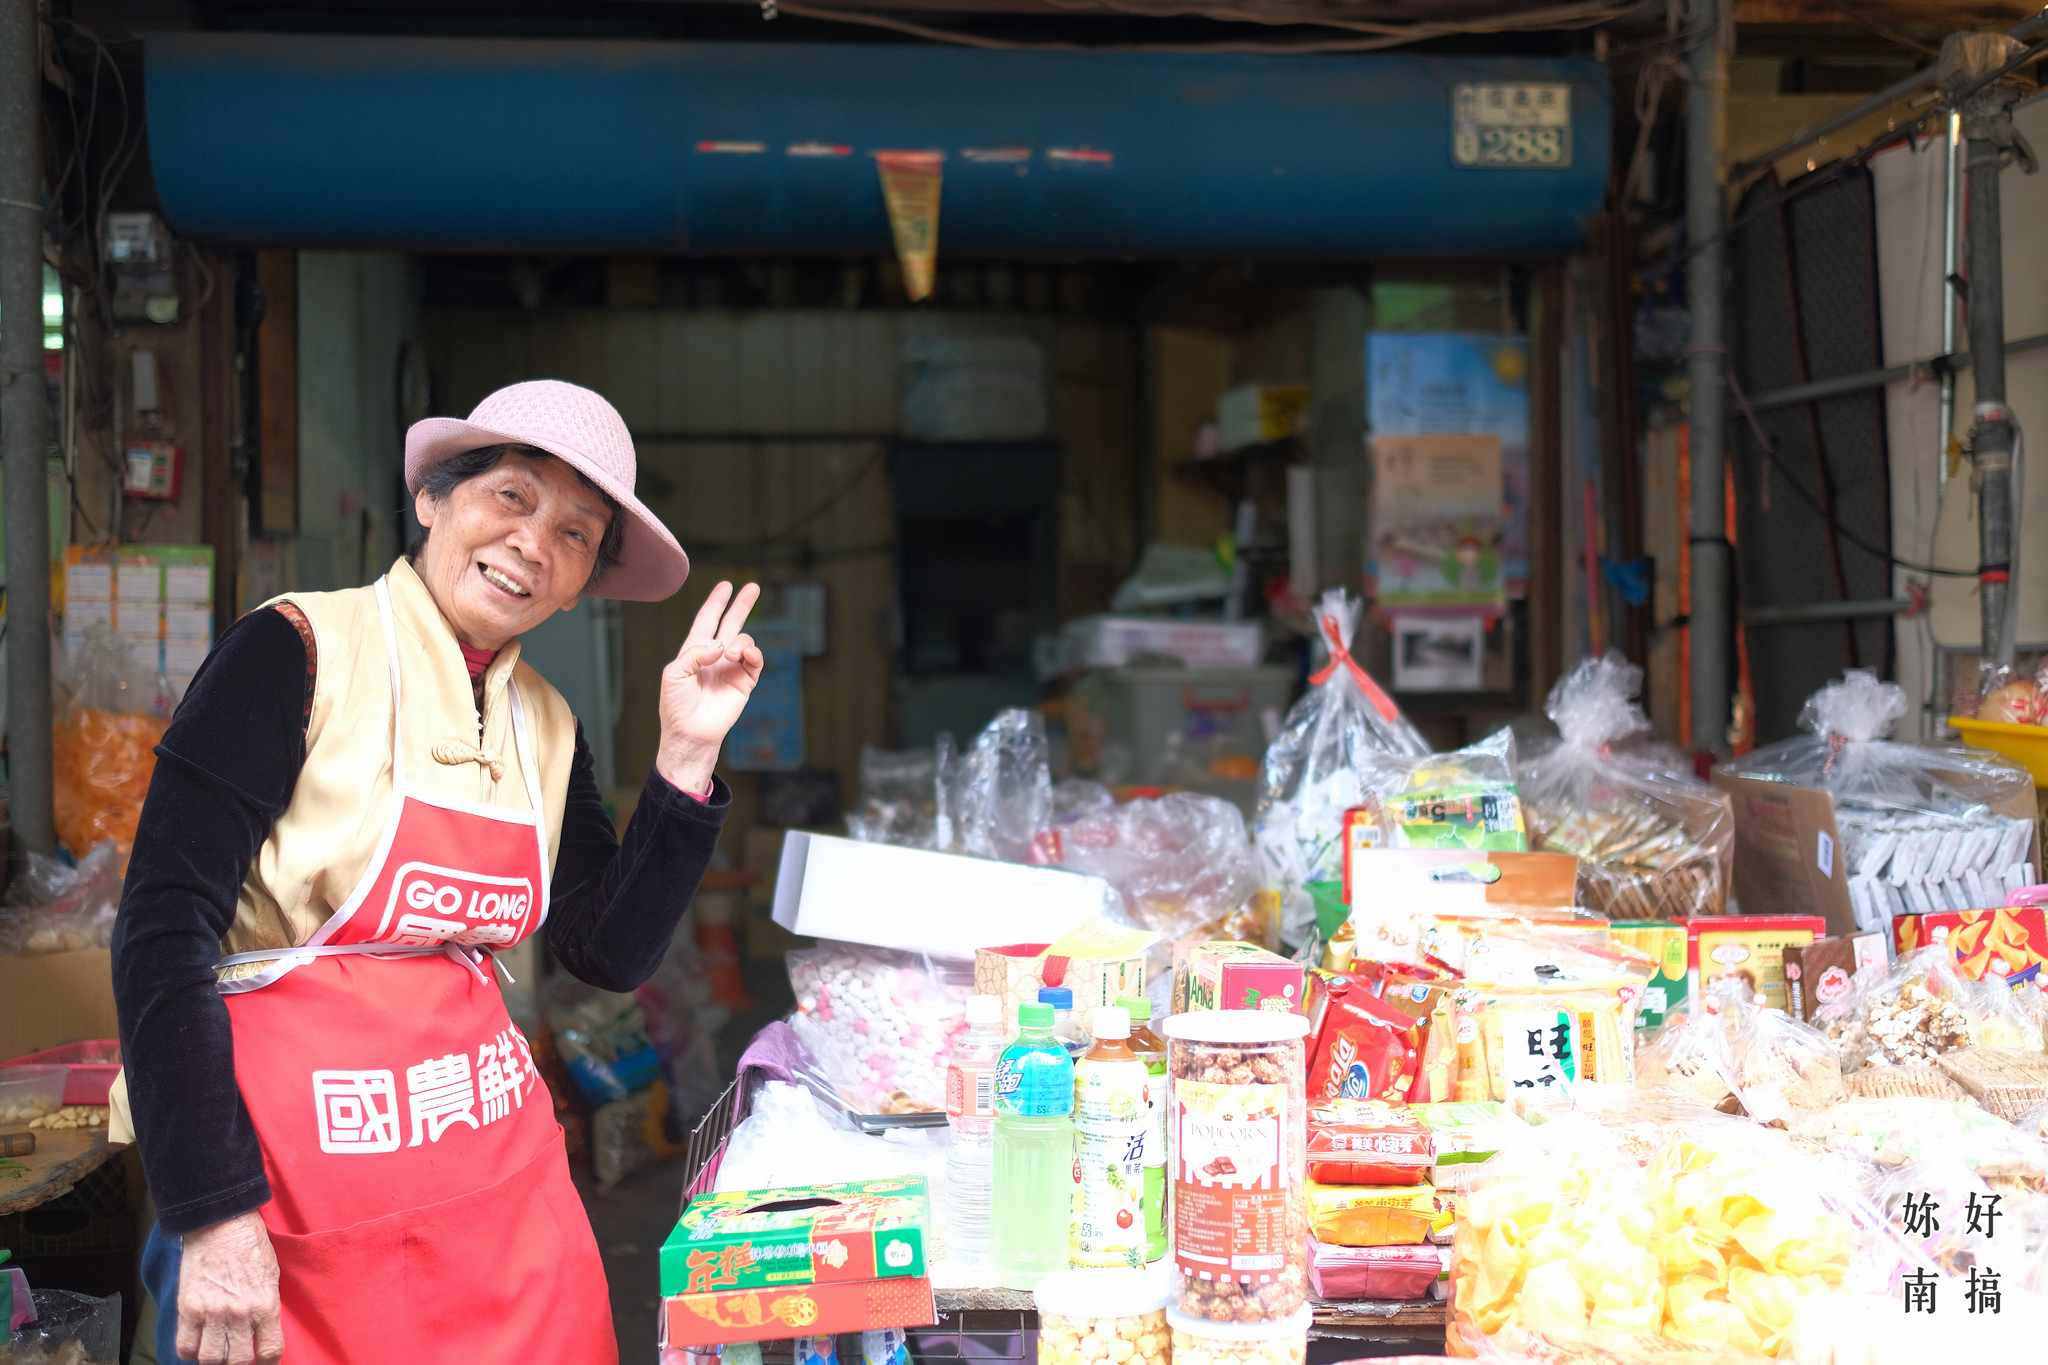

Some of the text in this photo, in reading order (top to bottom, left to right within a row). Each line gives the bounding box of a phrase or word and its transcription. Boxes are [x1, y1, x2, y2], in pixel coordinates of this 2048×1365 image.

[405, 879, 528, 922] GO LONG
[1191, 1120, 1267, 1139] POPCORN
